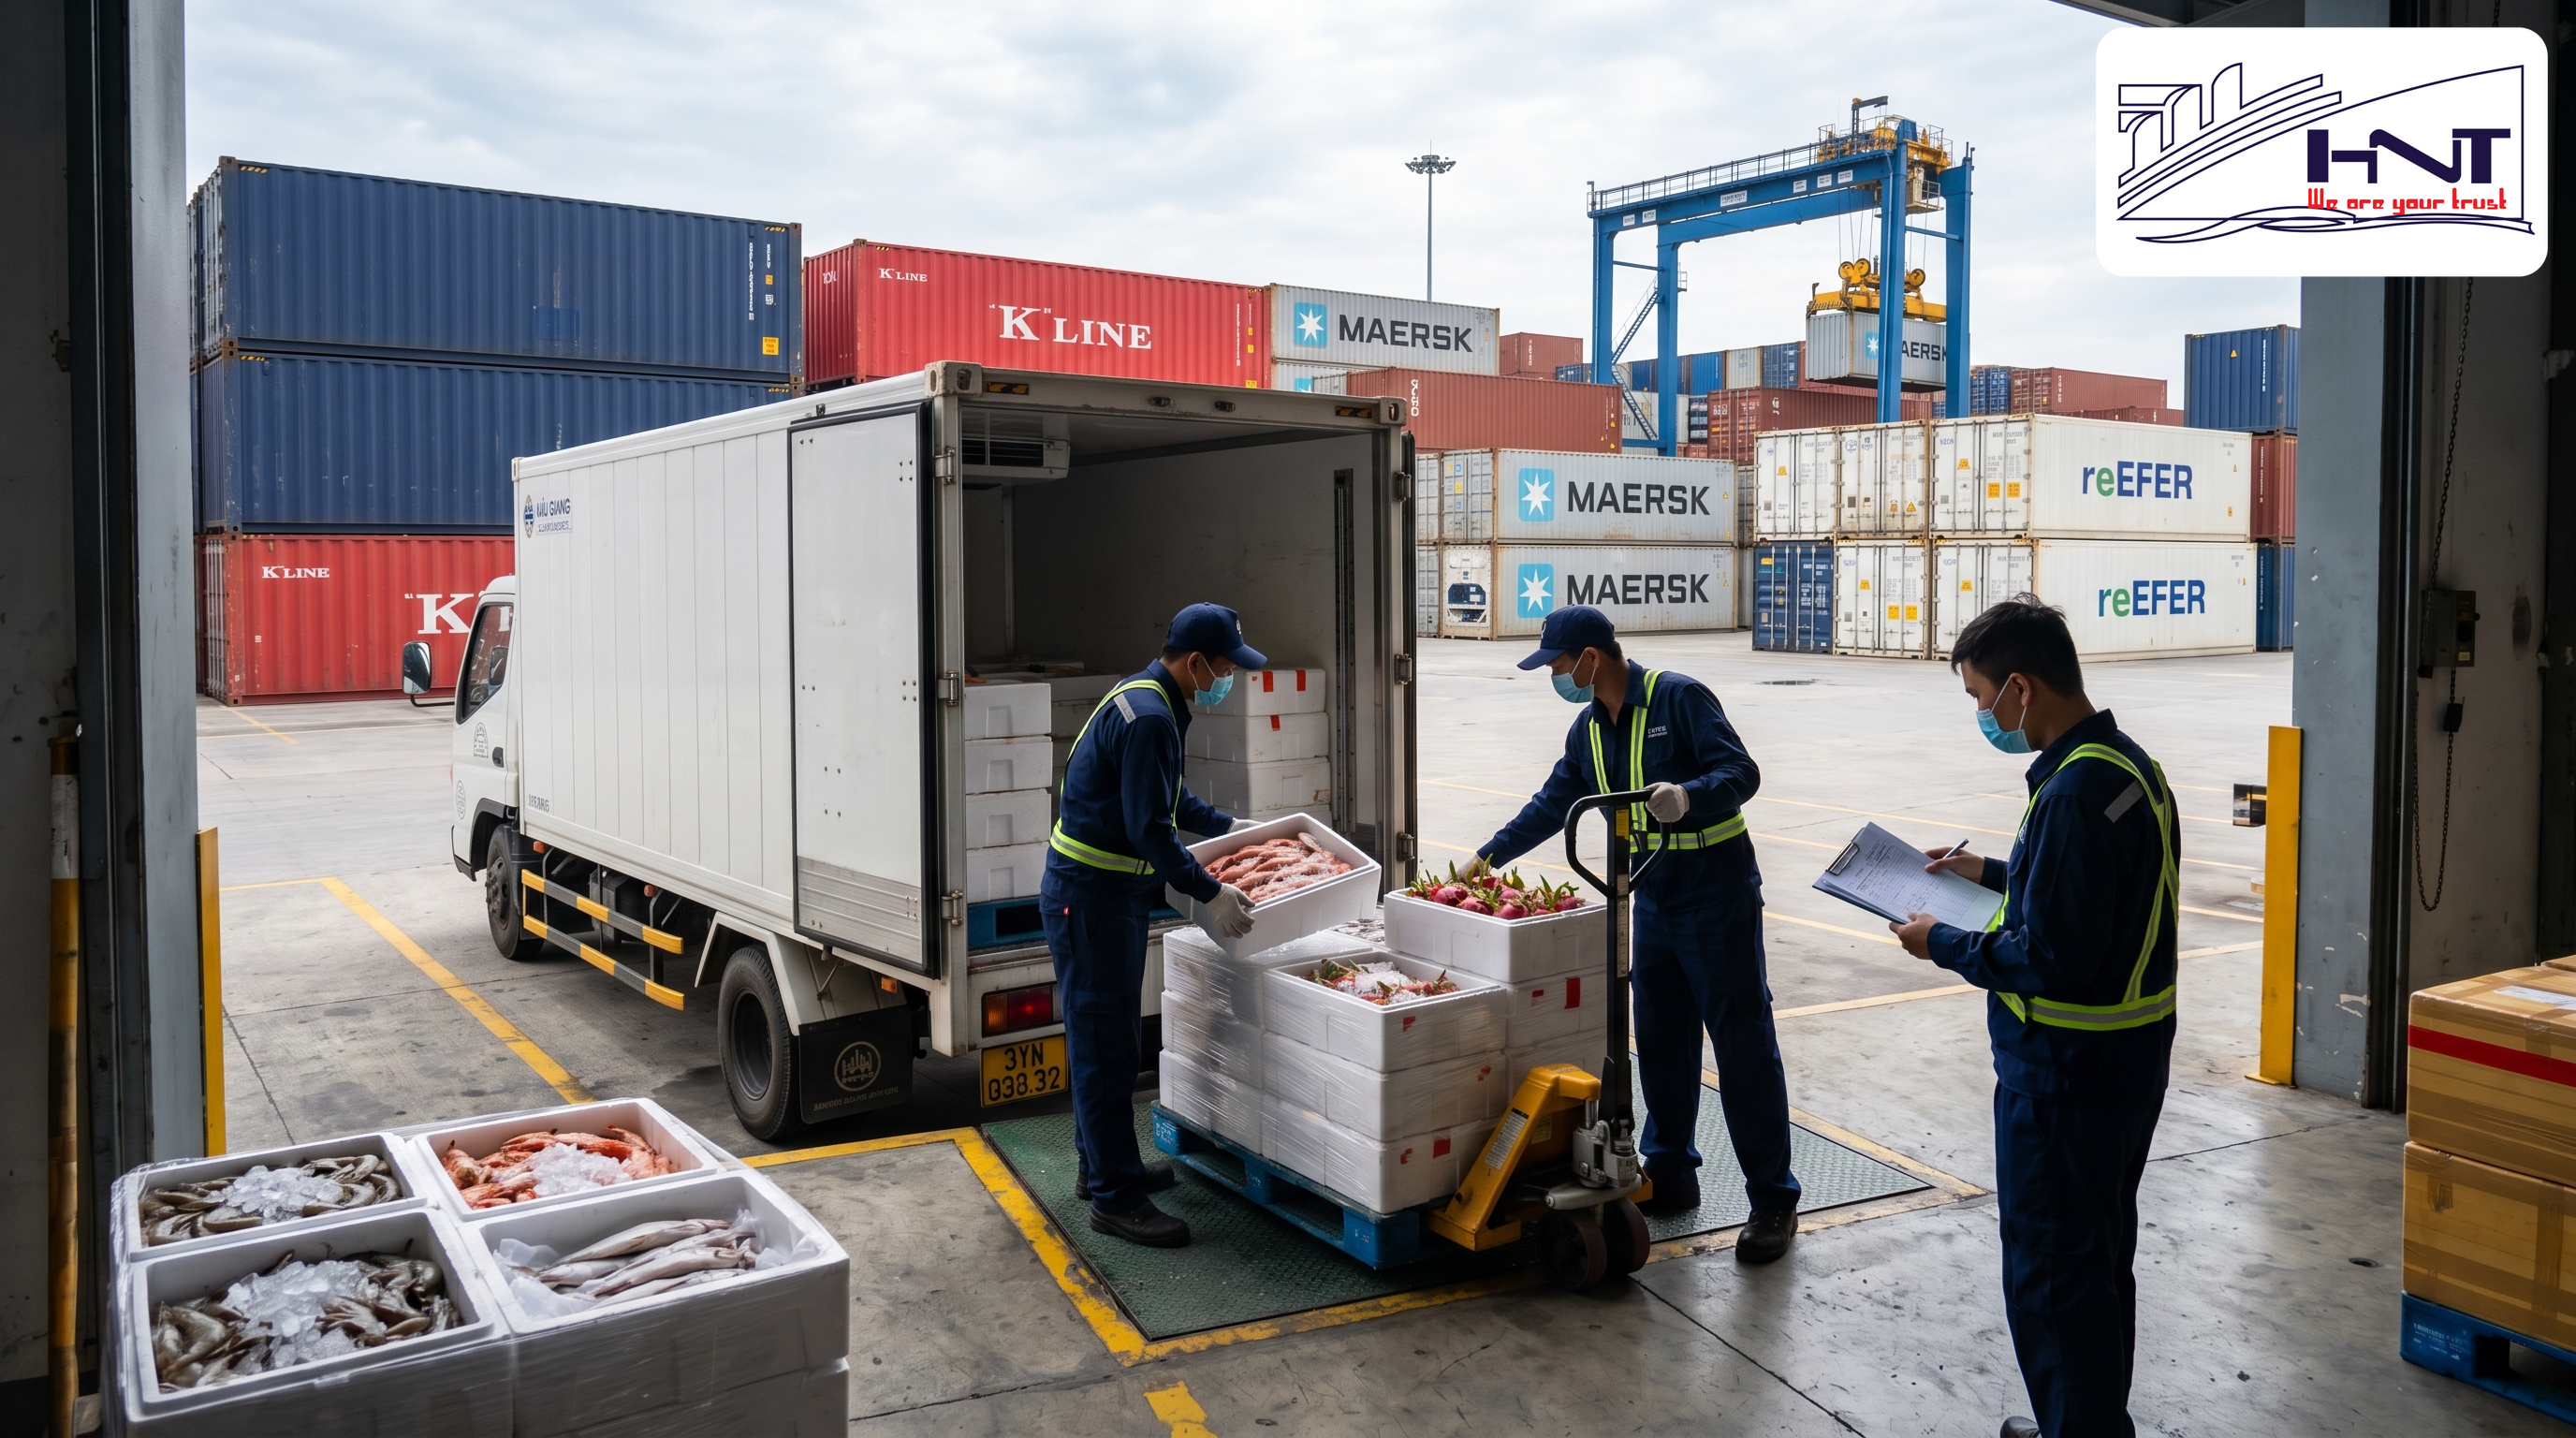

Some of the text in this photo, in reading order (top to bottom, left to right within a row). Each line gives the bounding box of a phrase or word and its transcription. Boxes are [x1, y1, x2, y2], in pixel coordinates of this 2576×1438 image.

[1053, 317, 1151, 349] LINE
[1339, 315, 1473, 353] MAERSK
[1901, 340, 1947, 361] AERS
[2082, 461, 2192, 499] reEFER
[1568, 481, 1710, 515] MAERSK
[1567, 574, 1710, 605] MAERSK
[2099, 580, 2205, 617] reEFER
[1004, 1042, 1044, 1071] 3YN
